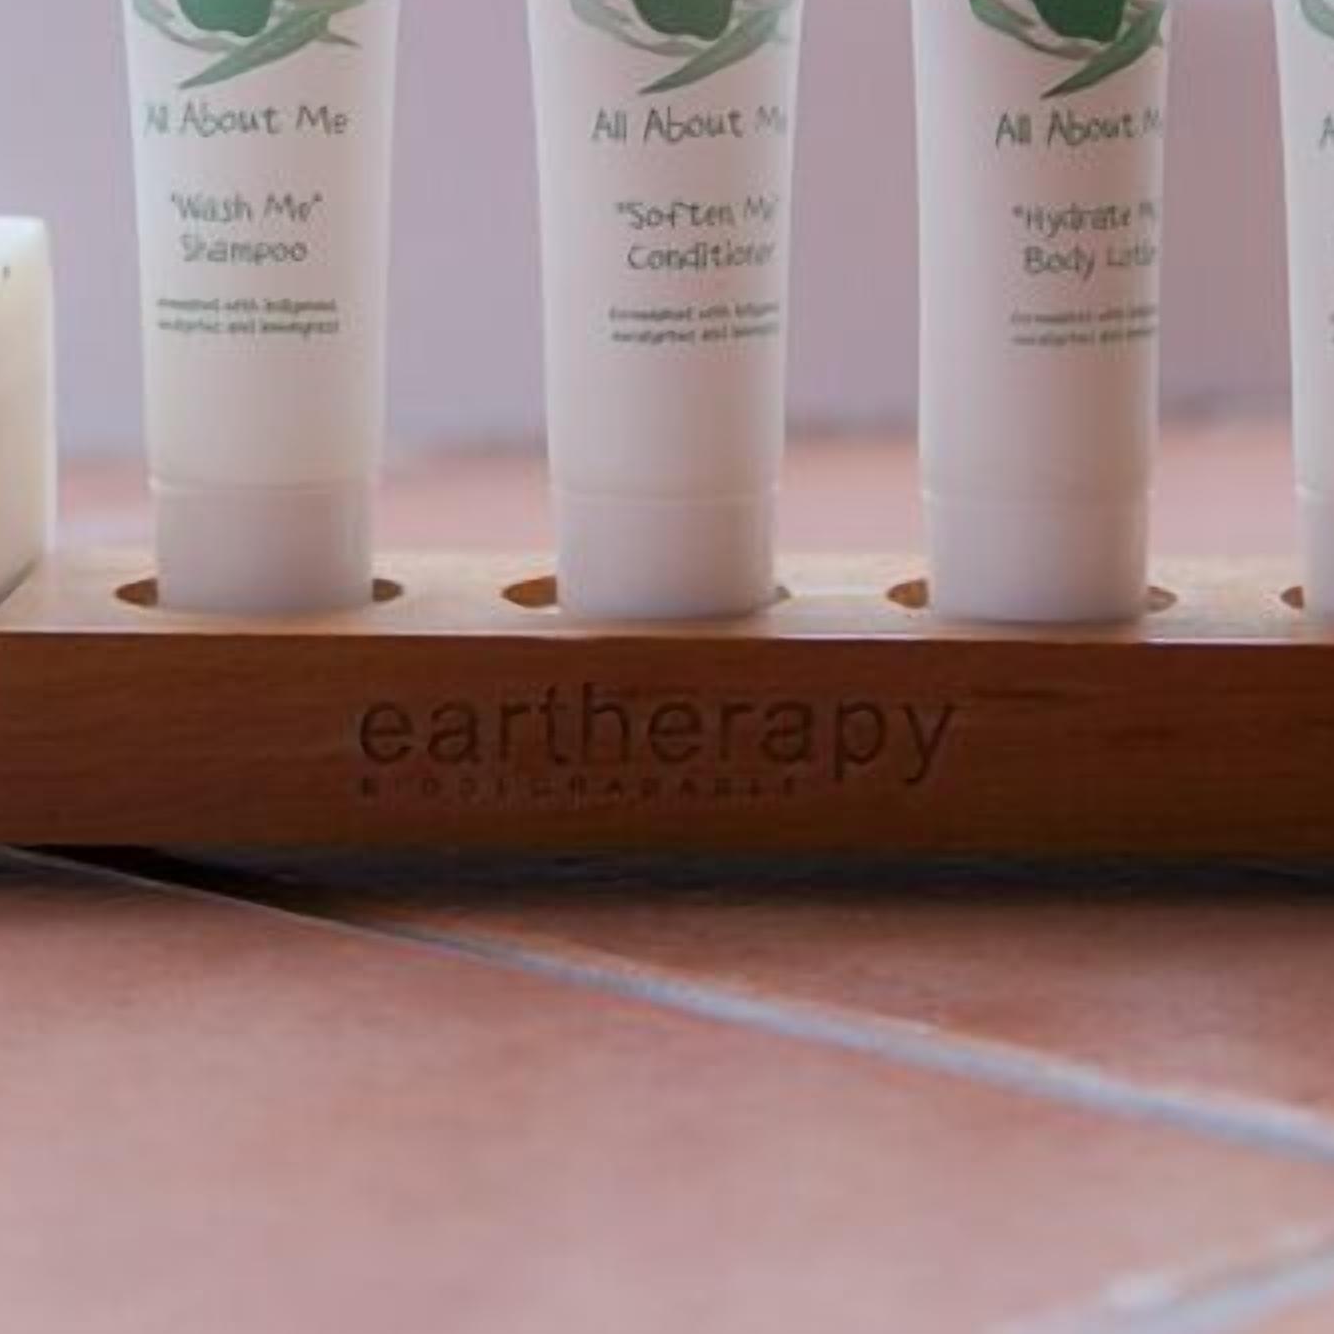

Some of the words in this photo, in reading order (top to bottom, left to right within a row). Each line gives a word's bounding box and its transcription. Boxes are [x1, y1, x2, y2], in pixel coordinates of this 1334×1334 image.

[178, 102, 283, 138] About
[295, 104, 350, 135] Me
[589, 107, 628, 143] All
[643, 106, 744, 144] About
[994, 111, 1032, 150] All
[1047, 109, 1135, 148] About
[1141, 107, 1161, 136] M
[180, 232, 309, 265] Shampoo
[1023, 242, 1096, 283] Body
[358, 681, 958, 787] eartherapy
